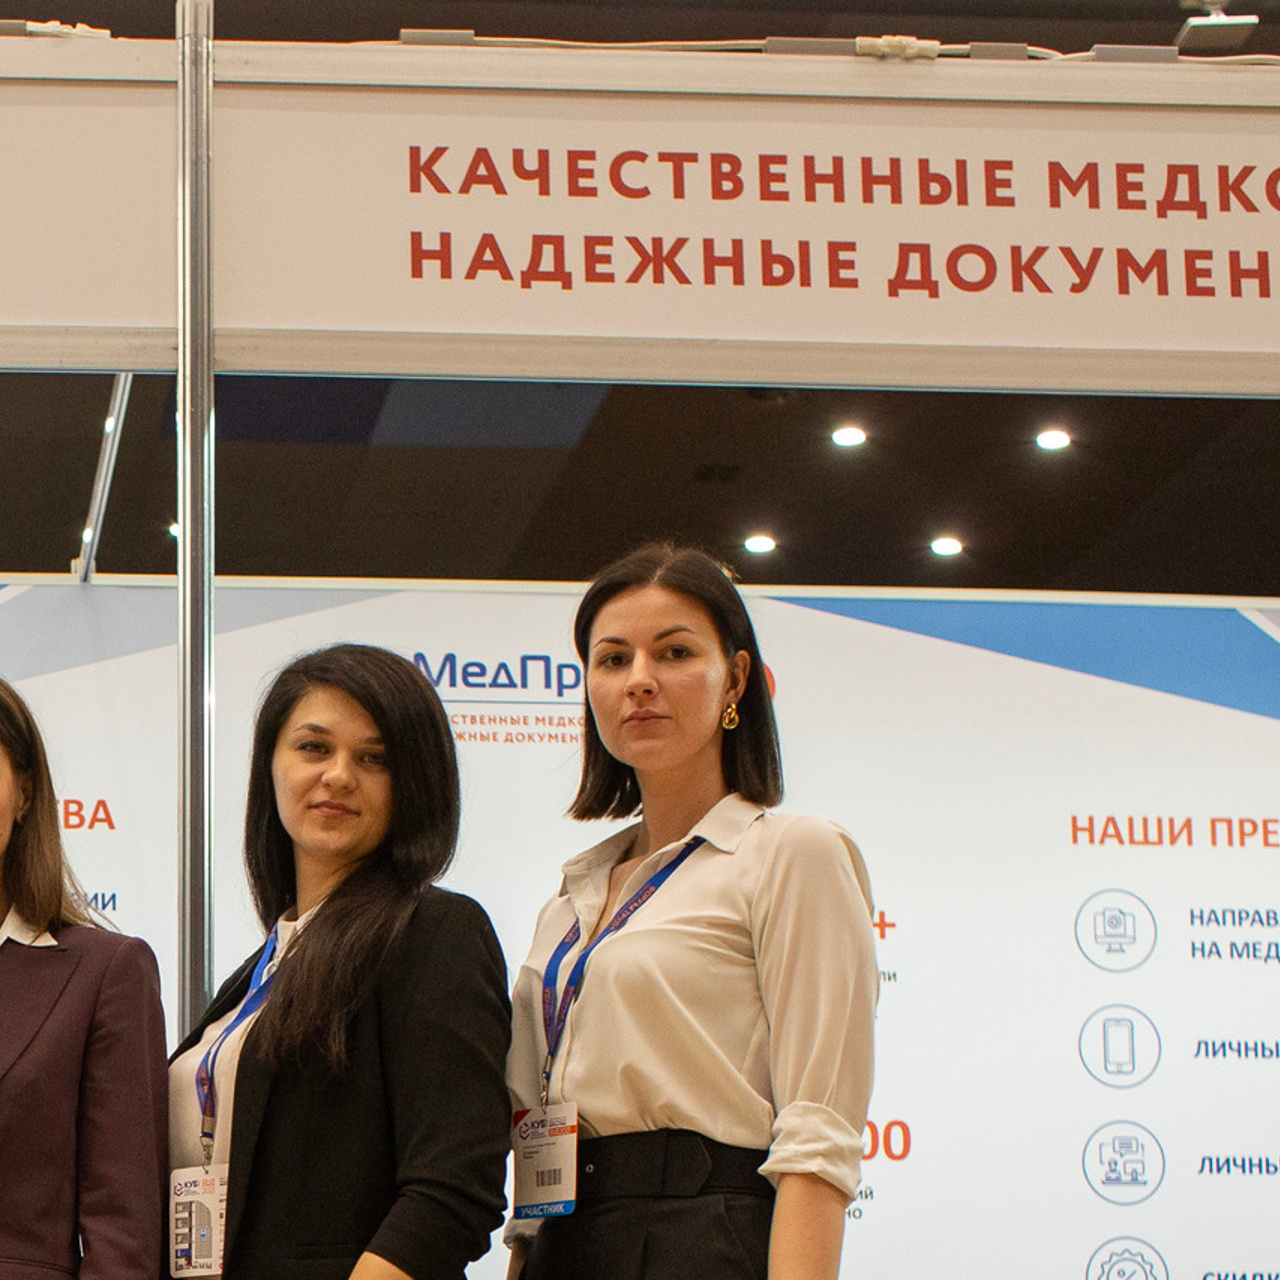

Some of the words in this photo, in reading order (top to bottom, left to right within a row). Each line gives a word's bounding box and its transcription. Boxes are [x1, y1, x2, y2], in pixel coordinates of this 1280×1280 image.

[408, 146, 1016, 208] КАЧЕСТВЕННЫЕ
[410, 231, 860, 291] НАДЕЖНЫЕ
[887, 242, 1271, 299] ДОКУМЕН
[1071, 815, 1194, 847] НАШИ
[1191, 942, 1222, 958] НА
[521, 1203, 565, 1217] УЧАСТНИК
